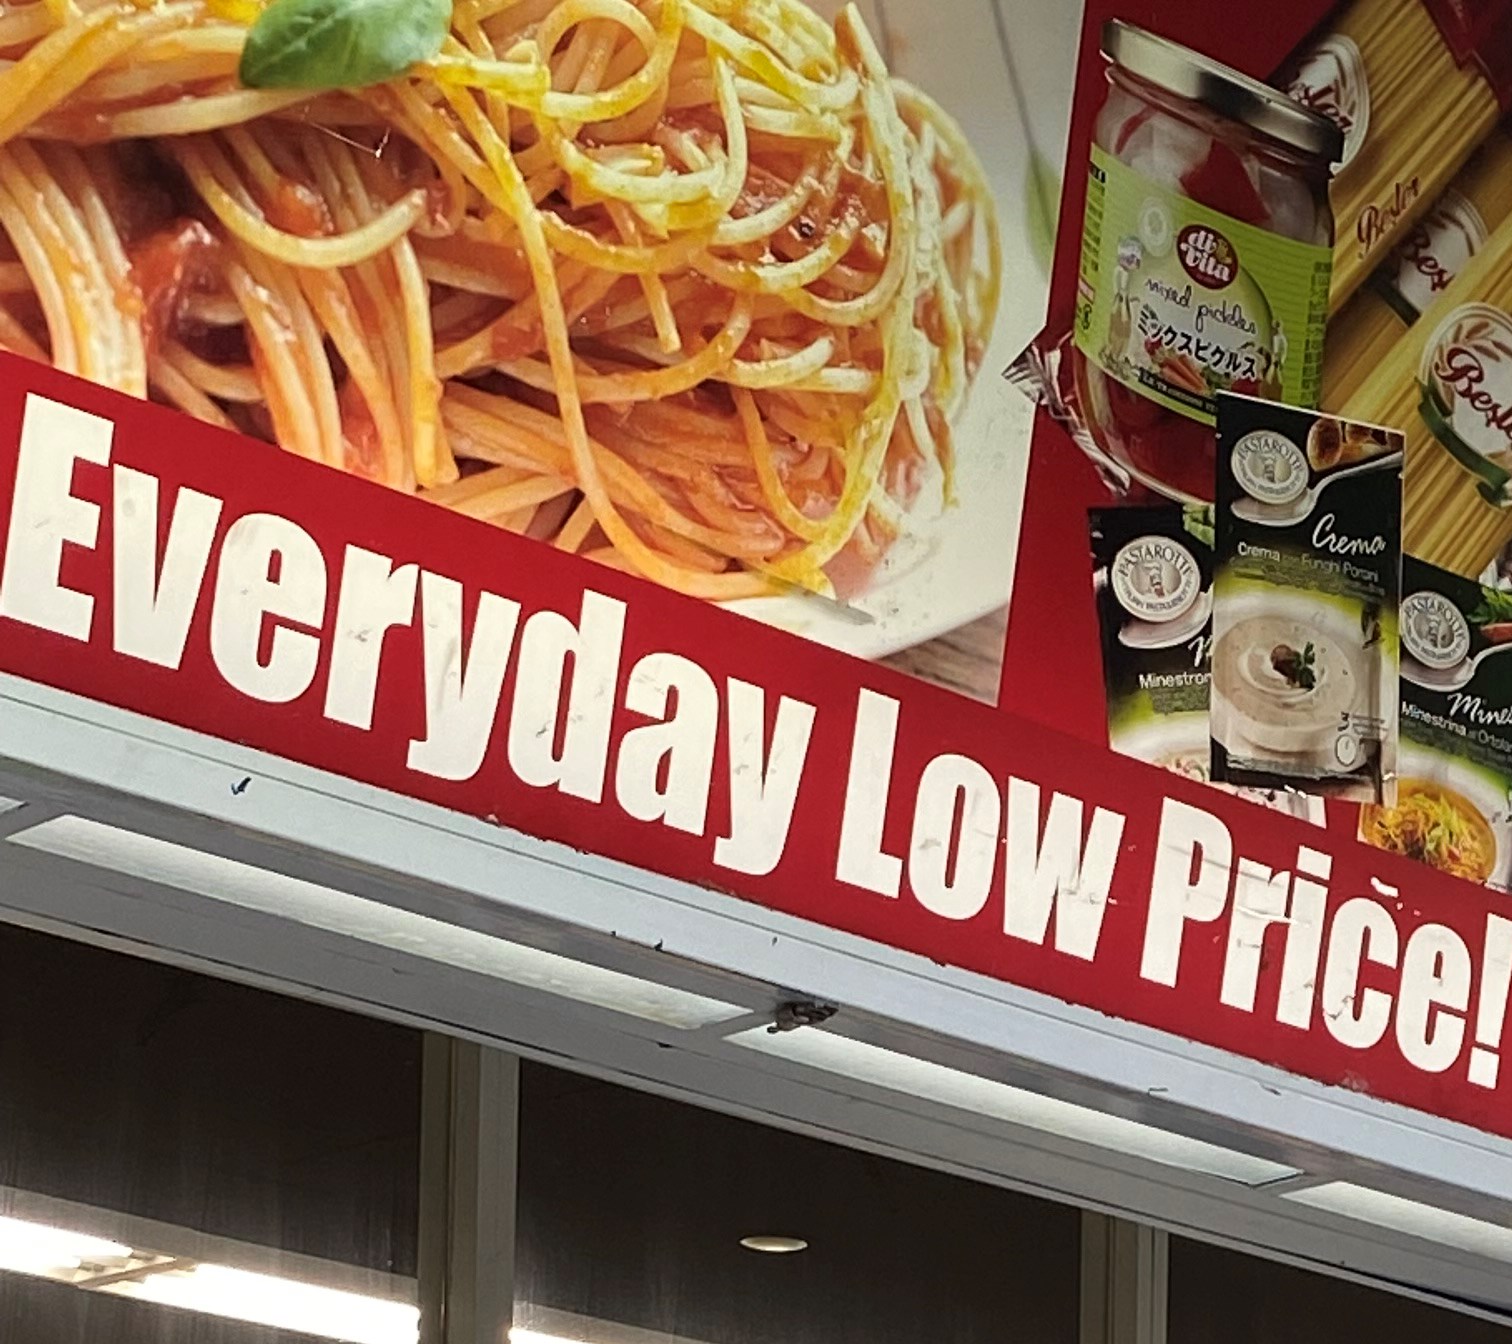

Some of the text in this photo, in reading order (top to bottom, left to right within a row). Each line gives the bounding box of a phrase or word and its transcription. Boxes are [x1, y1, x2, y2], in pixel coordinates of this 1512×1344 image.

[1137, 304, 1257, 379] ミックスピクルス
[1311, 513, 1387, 557] Crema
[0, 391, 817, 876] Everyday
[835, 687, 1135, 961] Low
